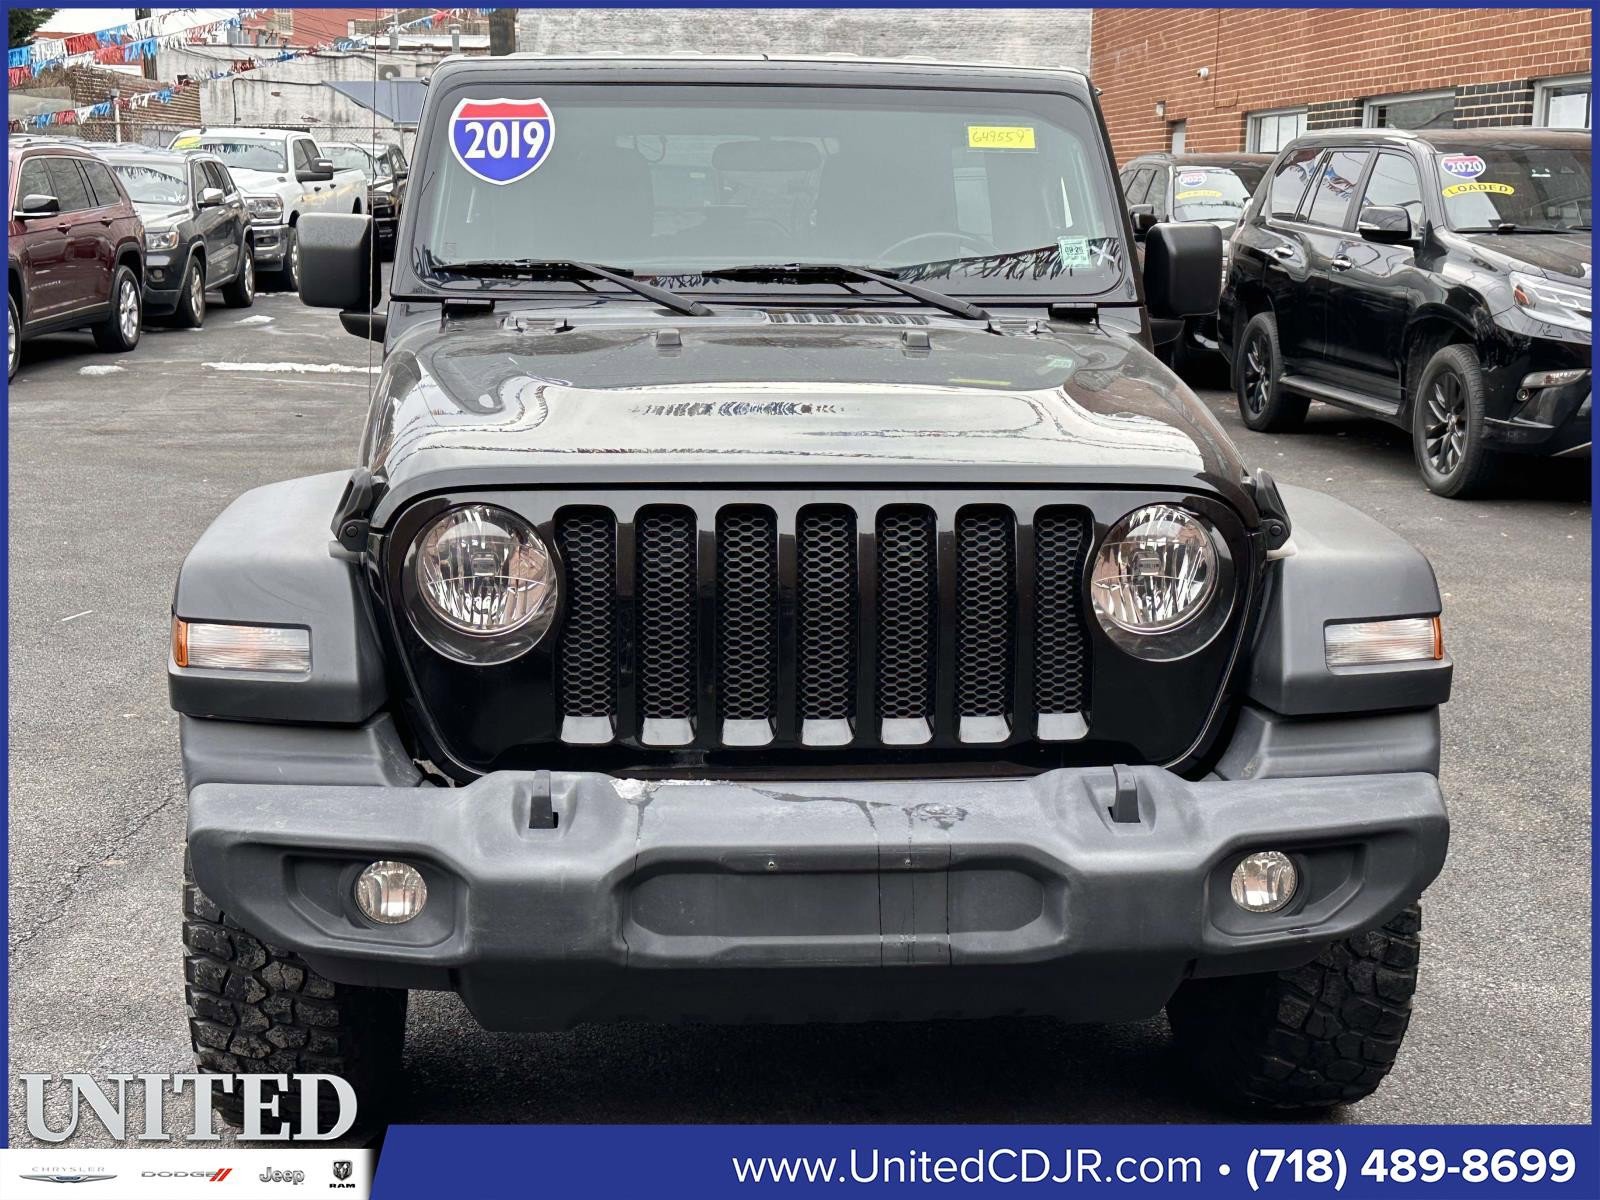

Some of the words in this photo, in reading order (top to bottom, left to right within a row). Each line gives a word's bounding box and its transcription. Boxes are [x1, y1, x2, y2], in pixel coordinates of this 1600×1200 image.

[464, 121, 545, 159] 2019
[1448, 161, 1482, 173] 2020
[1447, 184, 1509, 195] LOADED
